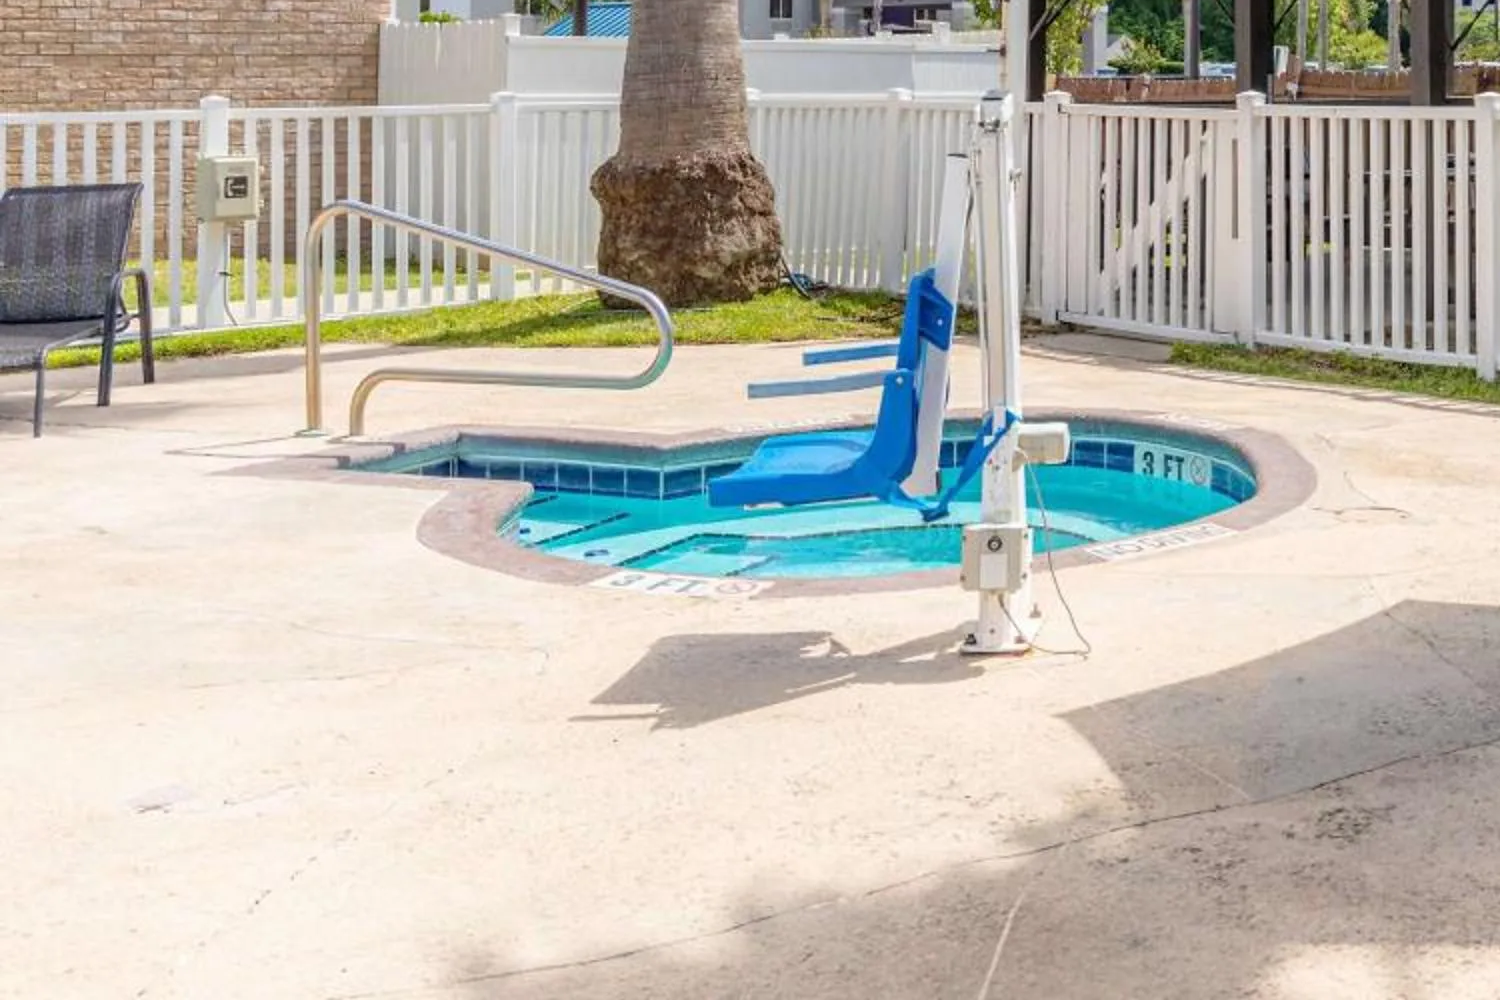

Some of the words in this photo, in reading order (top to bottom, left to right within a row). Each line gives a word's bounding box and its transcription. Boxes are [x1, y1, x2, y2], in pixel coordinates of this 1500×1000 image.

[1142, 451, 1154, 475] 3
[1163, 453, 1185, 481] FT
[610, 573, 646, 587] 3
[645, 577, 709, 593] FT
